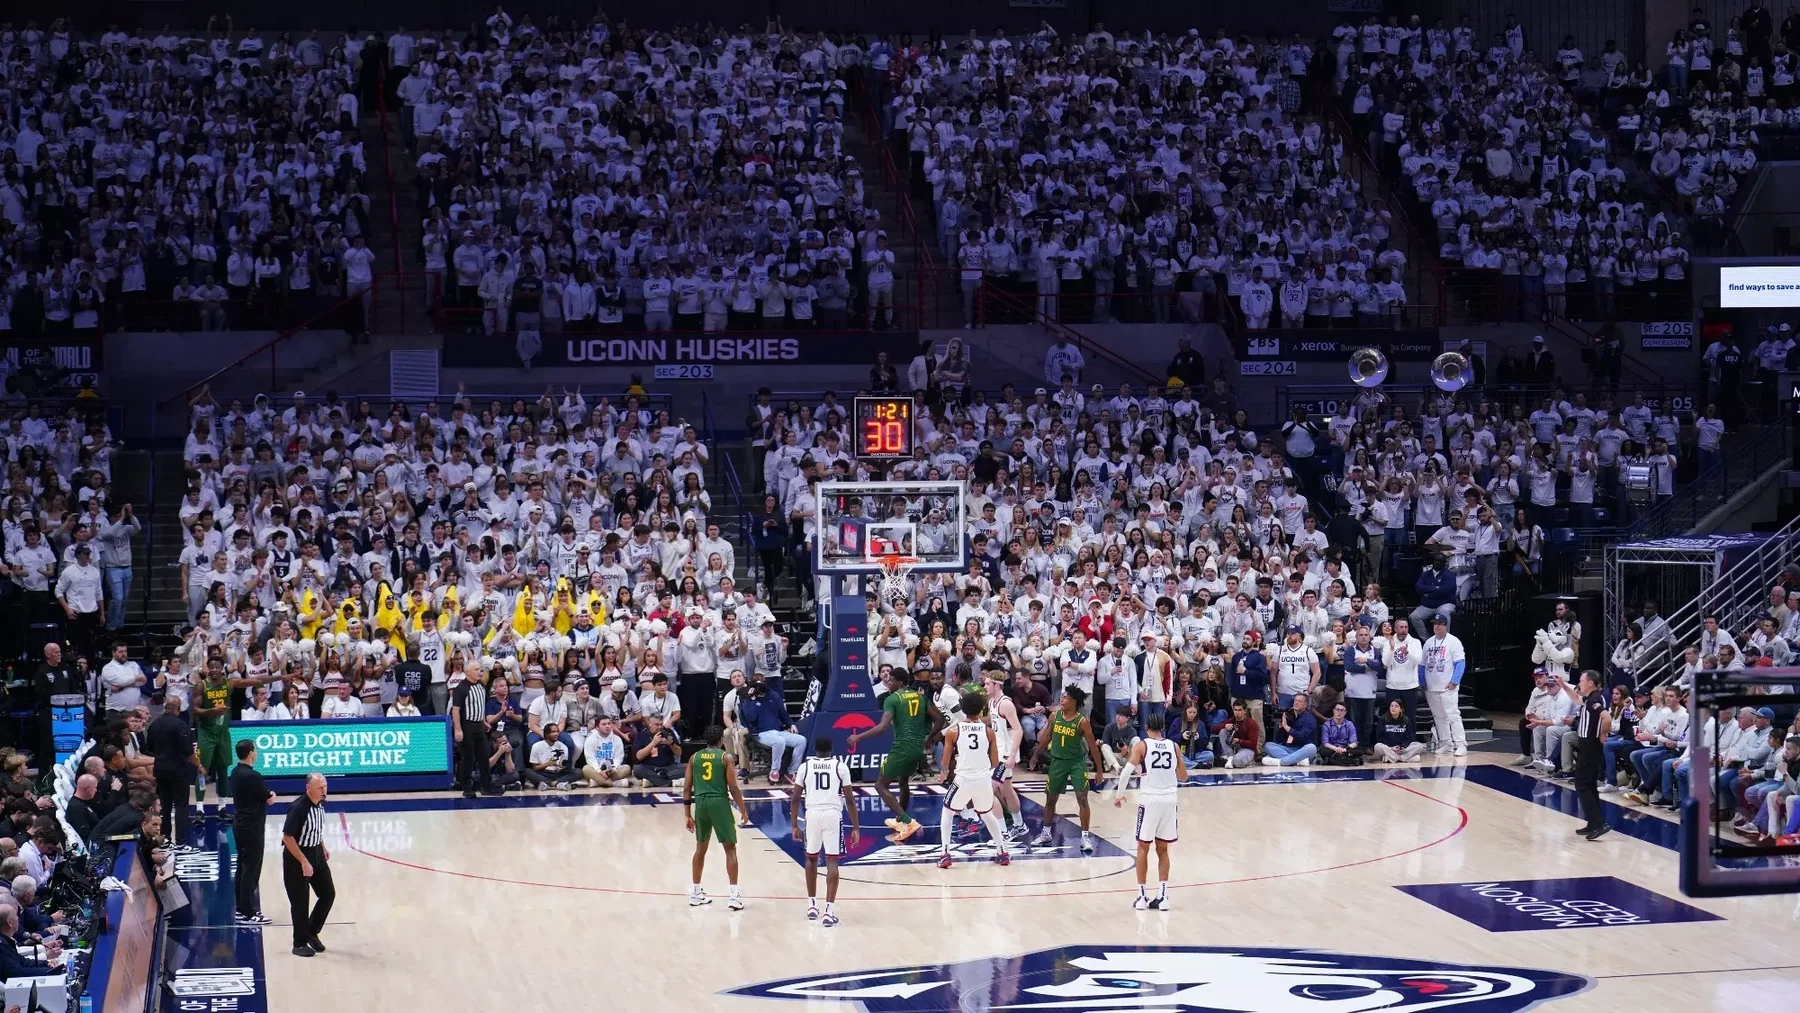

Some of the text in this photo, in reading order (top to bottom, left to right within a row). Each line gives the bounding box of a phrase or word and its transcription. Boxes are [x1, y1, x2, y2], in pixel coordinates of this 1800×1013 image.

[1729, 283, 1744, 291] find
[1746, 284, 1766, 292] ways
[1642, 322, 1691, 335] SEC 205
[25, 348, 41, 357] OF
[567, 338, 799, 361] UCONN HUSKIES
[1301, 341, 1336, 352] xerox
[1401, 343, 1432, 354] Company
[22, 356, 43, 365] THE
[656, 365, 713, 378] SEC 203
[1242, 361, 1295, 374] SEC 204
[876, 402, 907, 420] 1:21
[1317, 400, 1338, 414] 10
[866, 421, 902, 451] 30
[424, 649, 437, 661] 22
[1281, 656, 1305, 664] UCONN
[404, 671, 422, 679] CSC
[207, 689, 228, 700] BEARS
[908, 699, 919, 717] 17
[1053, 724, 1076, 737] BEARS
[256, 731, 412, 750] OLD DOMINION
[601, 741, 613, 750] BIG
[967, 733, 979, 750] 3
[263, 749, 406, 768] FREIGHT LINE
[1151, 750, 1172, 770] 23
[702, 761, 713, 781] 3
[814, 771, 831, 791] 10
[1461, 882, 1600, 928] MADISON
[1561, 899, 1651, 925] REED
[180, 1000, 207, 1011] OF
[211, 997, 238, 1012] THE
